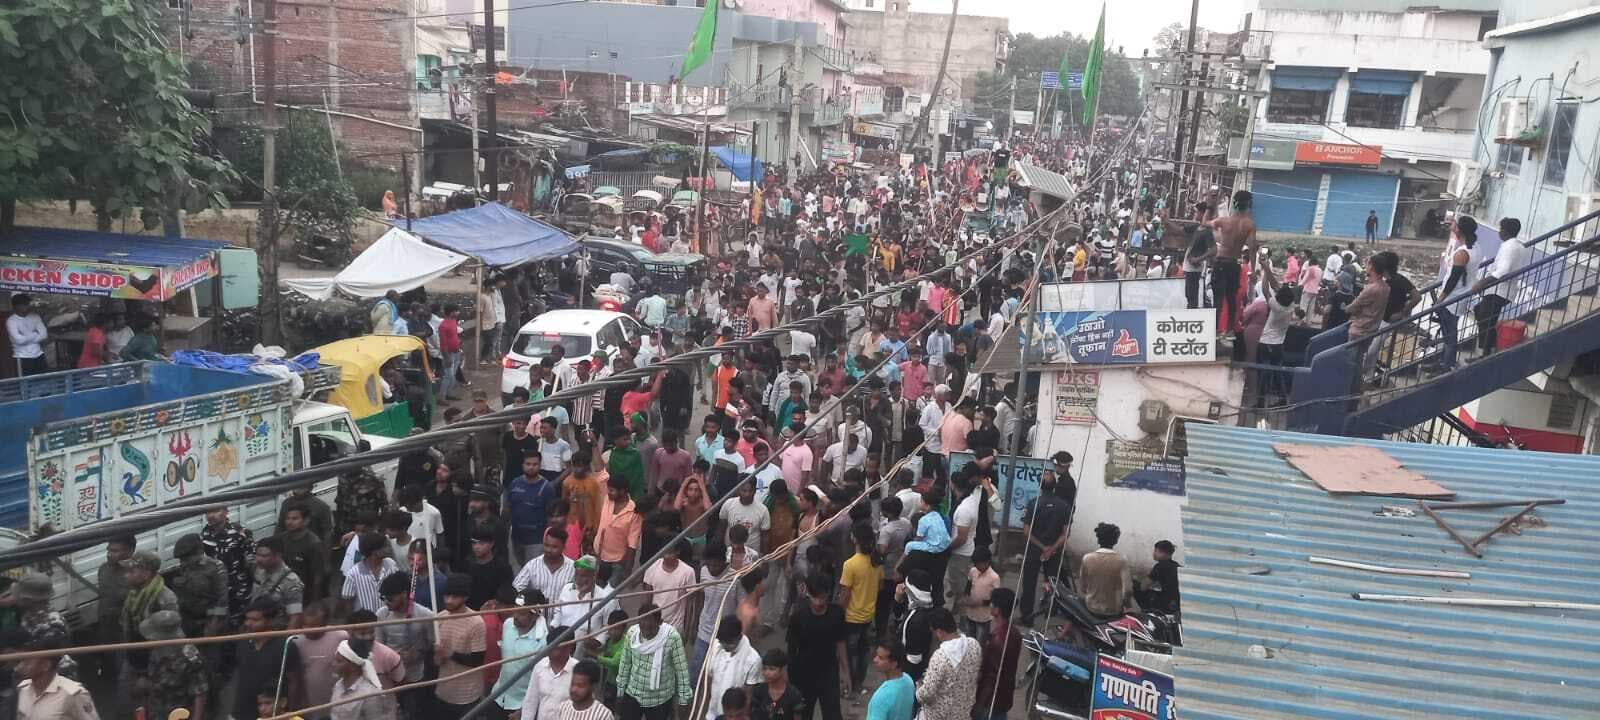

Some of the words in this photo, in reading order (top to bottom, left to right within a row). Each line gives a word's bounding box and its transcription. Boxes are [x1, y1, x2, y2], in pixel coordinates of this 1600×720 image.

[67, 272, 126, 288] SHOP
[1156, 316, 1205, 334] कोमल
[1152, 337, 1168, 355] टी
[1170, 337, 1209, 356] स्टॉल
[1100, 673, 1161, 715] गणपति
